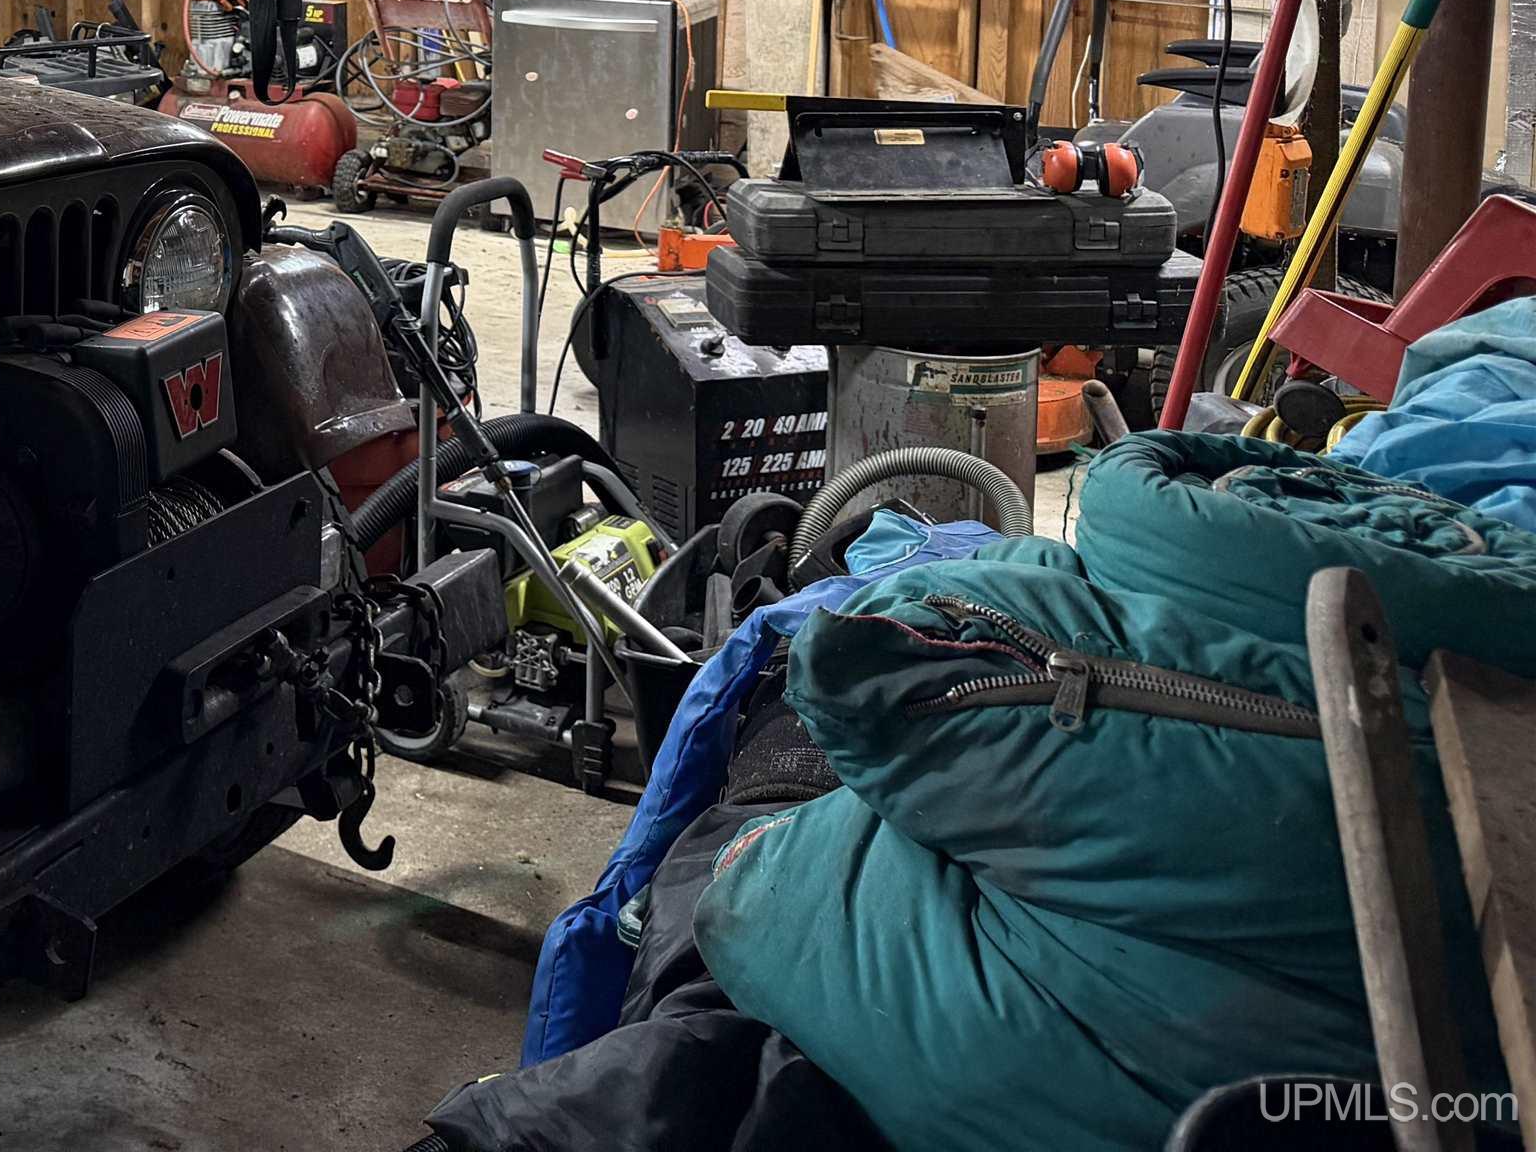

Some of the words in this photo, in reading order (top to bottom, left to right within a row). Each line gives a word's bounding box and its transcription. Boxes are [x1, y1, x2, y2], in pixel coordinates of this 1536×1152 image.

[306, 5, 314, 17] 5
[215, 106, 284, 128] Powermate
[210, 122, 275, 138] PROFESSIONAL
[950, 371, 1021, 385] SANDBLASTER
[165, 352, 223, 440] W
[720, 421, 735, 440] 2
[741, 418, 766, 438] 20
[773, 415, 796, 435] 40
[722, 456, 752, 477] 125
[760, 452, 794, 473] 225
[780, 480, 822, 492] TESTE
